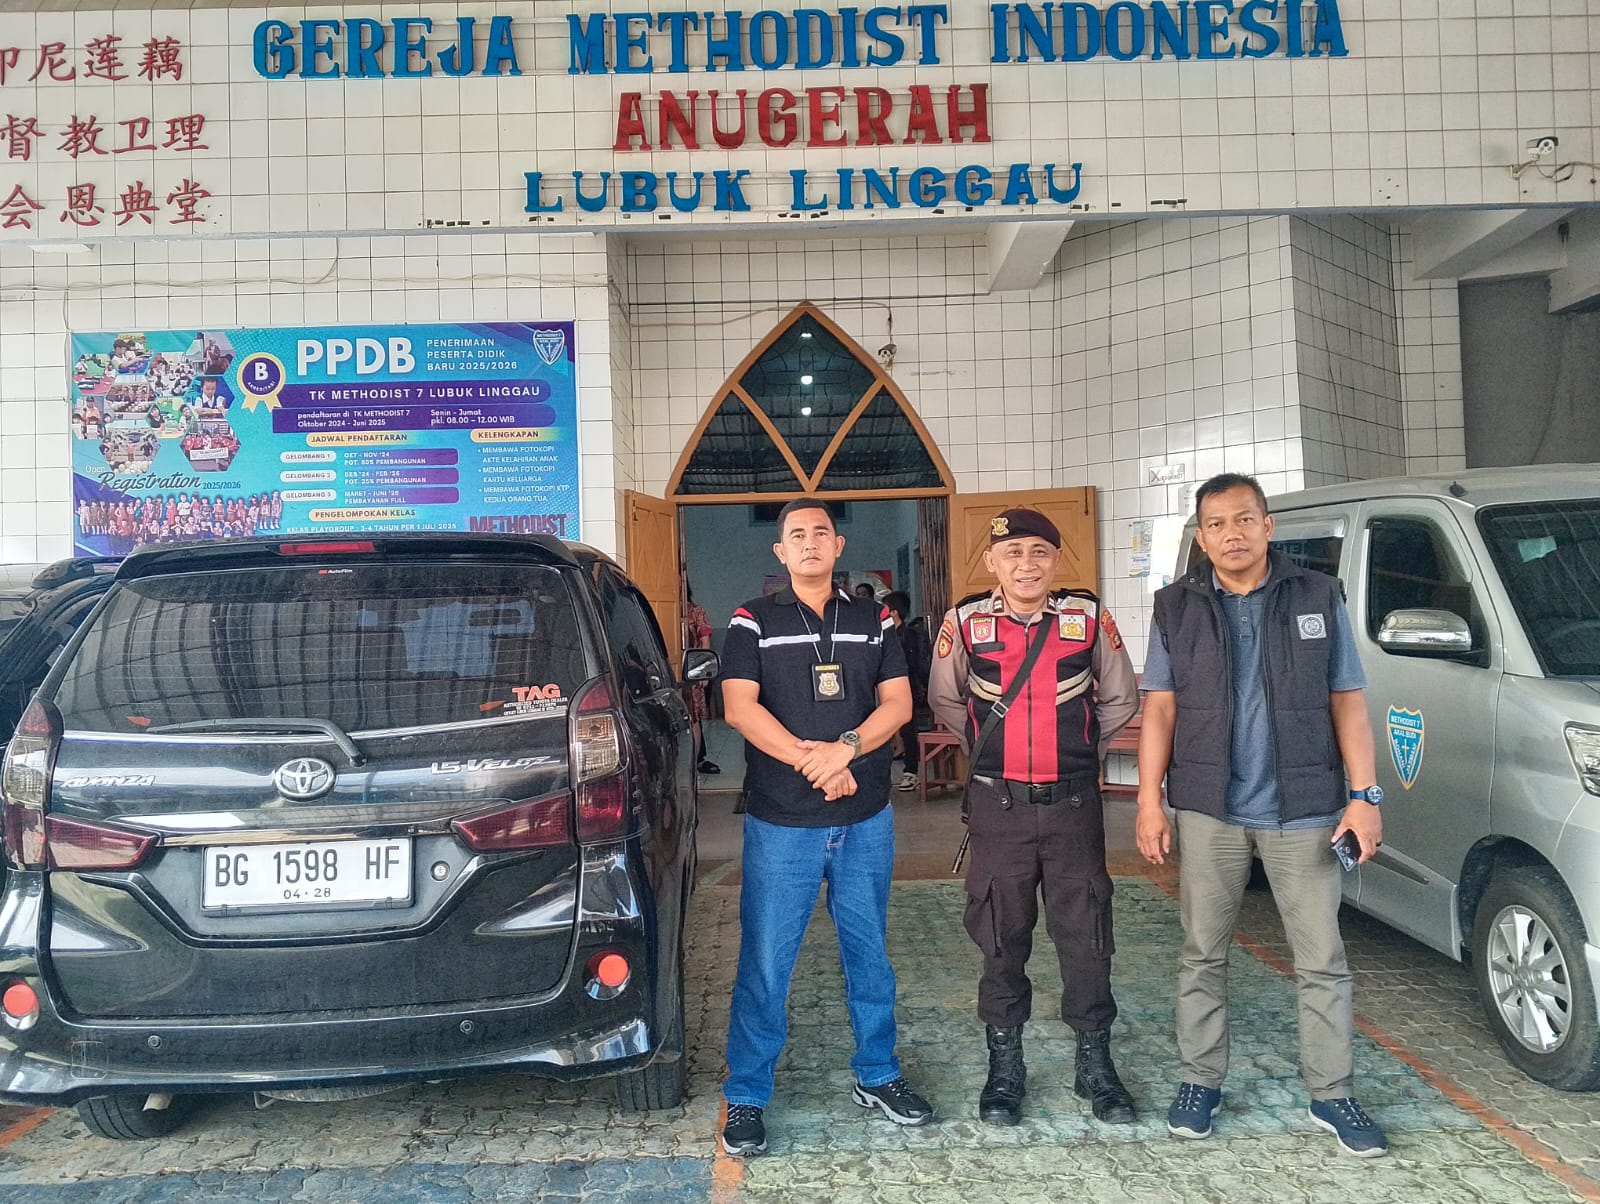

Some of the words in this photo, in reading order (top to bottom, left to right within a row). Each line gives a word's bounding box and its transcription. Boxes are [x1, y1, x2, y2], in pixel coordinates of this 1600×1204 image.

[253, 16, 522, 79] GEREJA
[566, 5, 947, 75] METHODIST
[991, 0, 1349, 63] INDONESIA
[612, 83, 992, 152] ANUGERAH
[0, 113, 209, 161] 督教卫理
[524, 169, 751, 214] LUBUK
[791, 162, 1083, 211] LINGGAU
[0, 178, 211, 229] 会恩典堂
[426, 338, 495, 347] PENERIMAAN
[297, 337, 416, 376] PPDB
[427, 350, 474, 359] PESERTA
[477, 350, 505, 358] DIDIK
[254, 362, 269, 380] B
[427, 362, 455, 371] BARU
[459, 361, 518, 370] 2025/2026
[309, 390, 326, 400] TK
[331, 388, 411, 400] METHODIST
[416, 388, 424, 398] 7
[429, 387, 473, 398] LUBUK
[479, 386, 540, 397] LINGGAU
[297, 411, 342, 420] pendaftaran
[343, 410, 350, 418] di
[458, 408, 482, 416] Jumat
[297, 419, 326, 428] Oktober
[327, 419, 346, 427] 2024
[352, 419, 367, 427] Juni
[368, 418, 386, 426] 2025
[446, 416, 469, 424] 08.00
[311, 435, 345, 443] JADWAL
[347, 433, 408, 442] PENDAFTARAN
[478, 431, 539, 439] KELENGKAPAN
[285, 453, 326, 461] GELOMBANG
[482, 466, 519, 474] MEMBAWA
[98, 471, 201, 496] Registration
[202, 481, 241, 490] 2025/2026
[315, 509, 388, 518] PENGELOMPOKAN
[389, 509, 416, 517] KELAS
[469, 514, 567, 537] METHODIST
[512, 683, 561, 702] TAG
[215, 853, 249, 887] BG
[273, 848, 338, 884] 1598
[365, 845, 400, 880] HF
